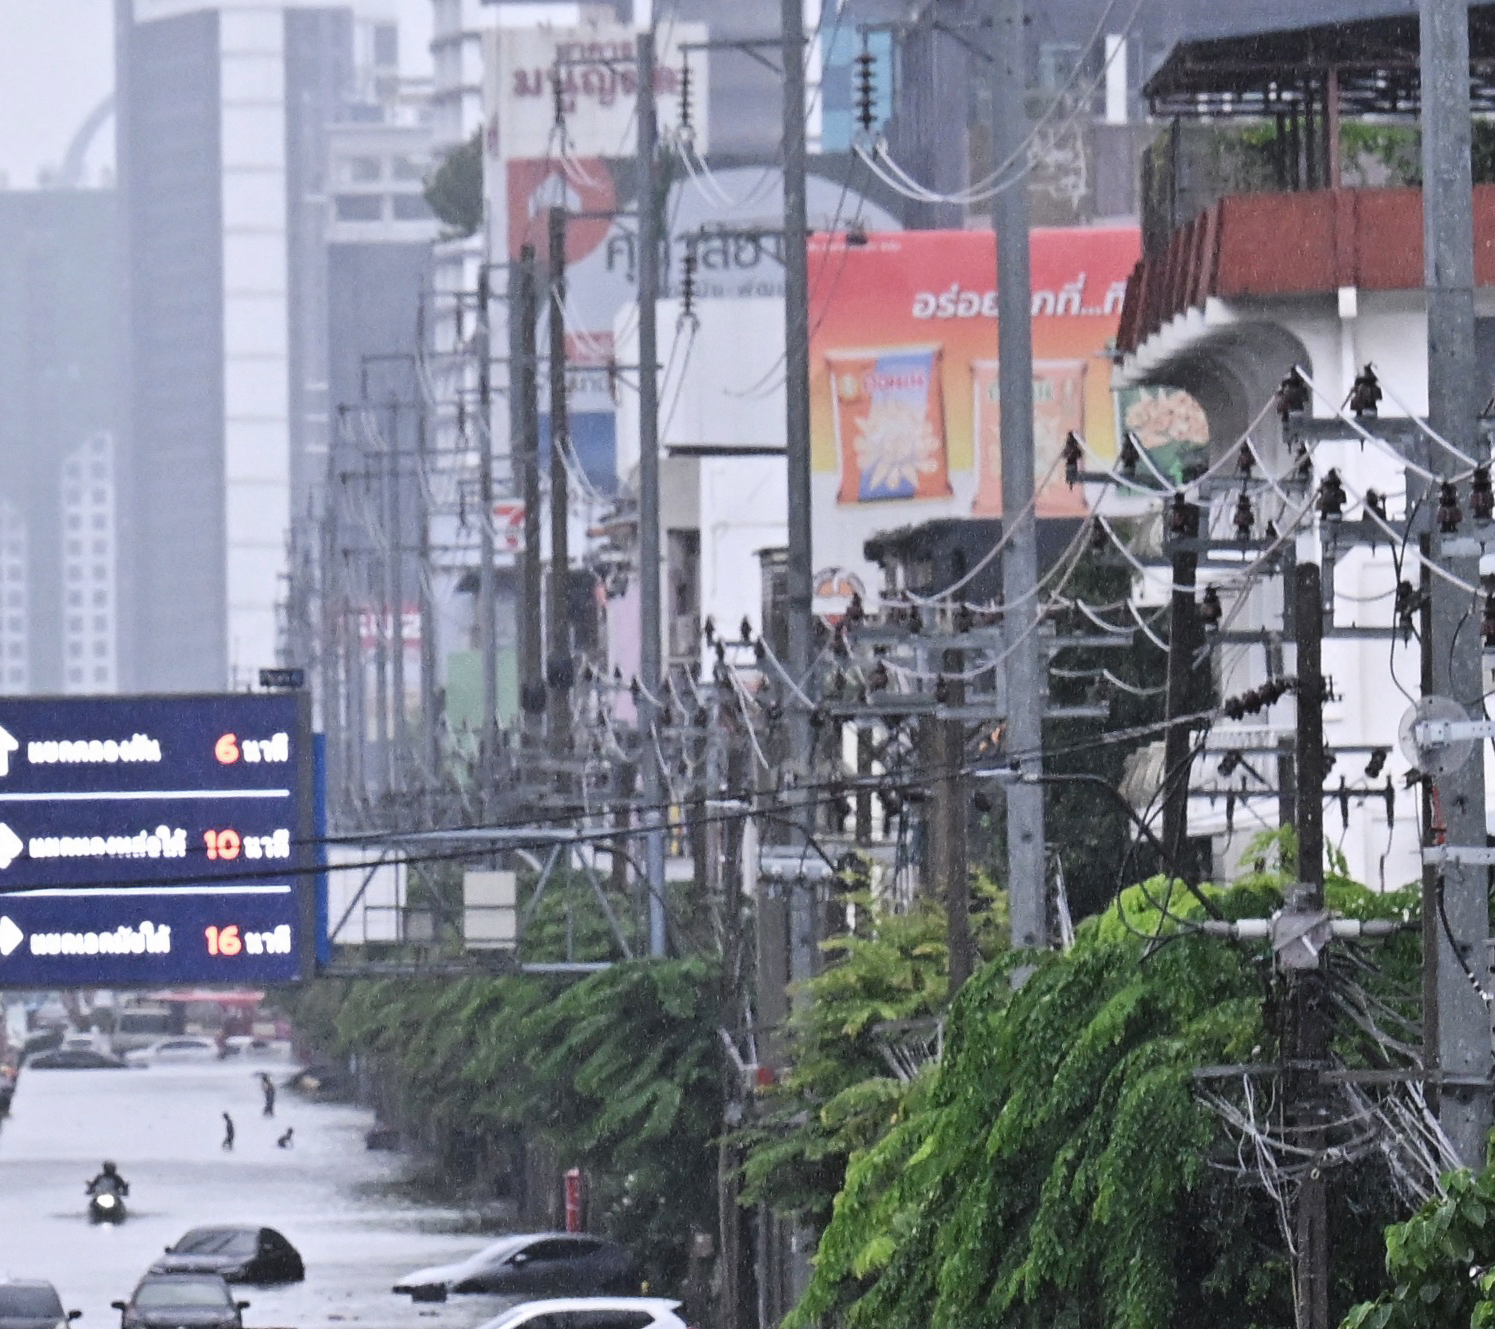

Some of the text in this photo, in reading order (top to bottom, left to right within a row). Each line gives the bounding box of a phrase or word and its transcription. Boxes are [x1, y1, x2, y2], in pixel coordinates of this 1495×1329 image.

[215, 733, 240, 764] 6
[242, 732, 289, 763] นาที
[204, 829, 241, 860] 10
[243, 828, 290, 859] นาที
[205, 925, 242, 956] 16
[244, 924, 291, 955] นาที
